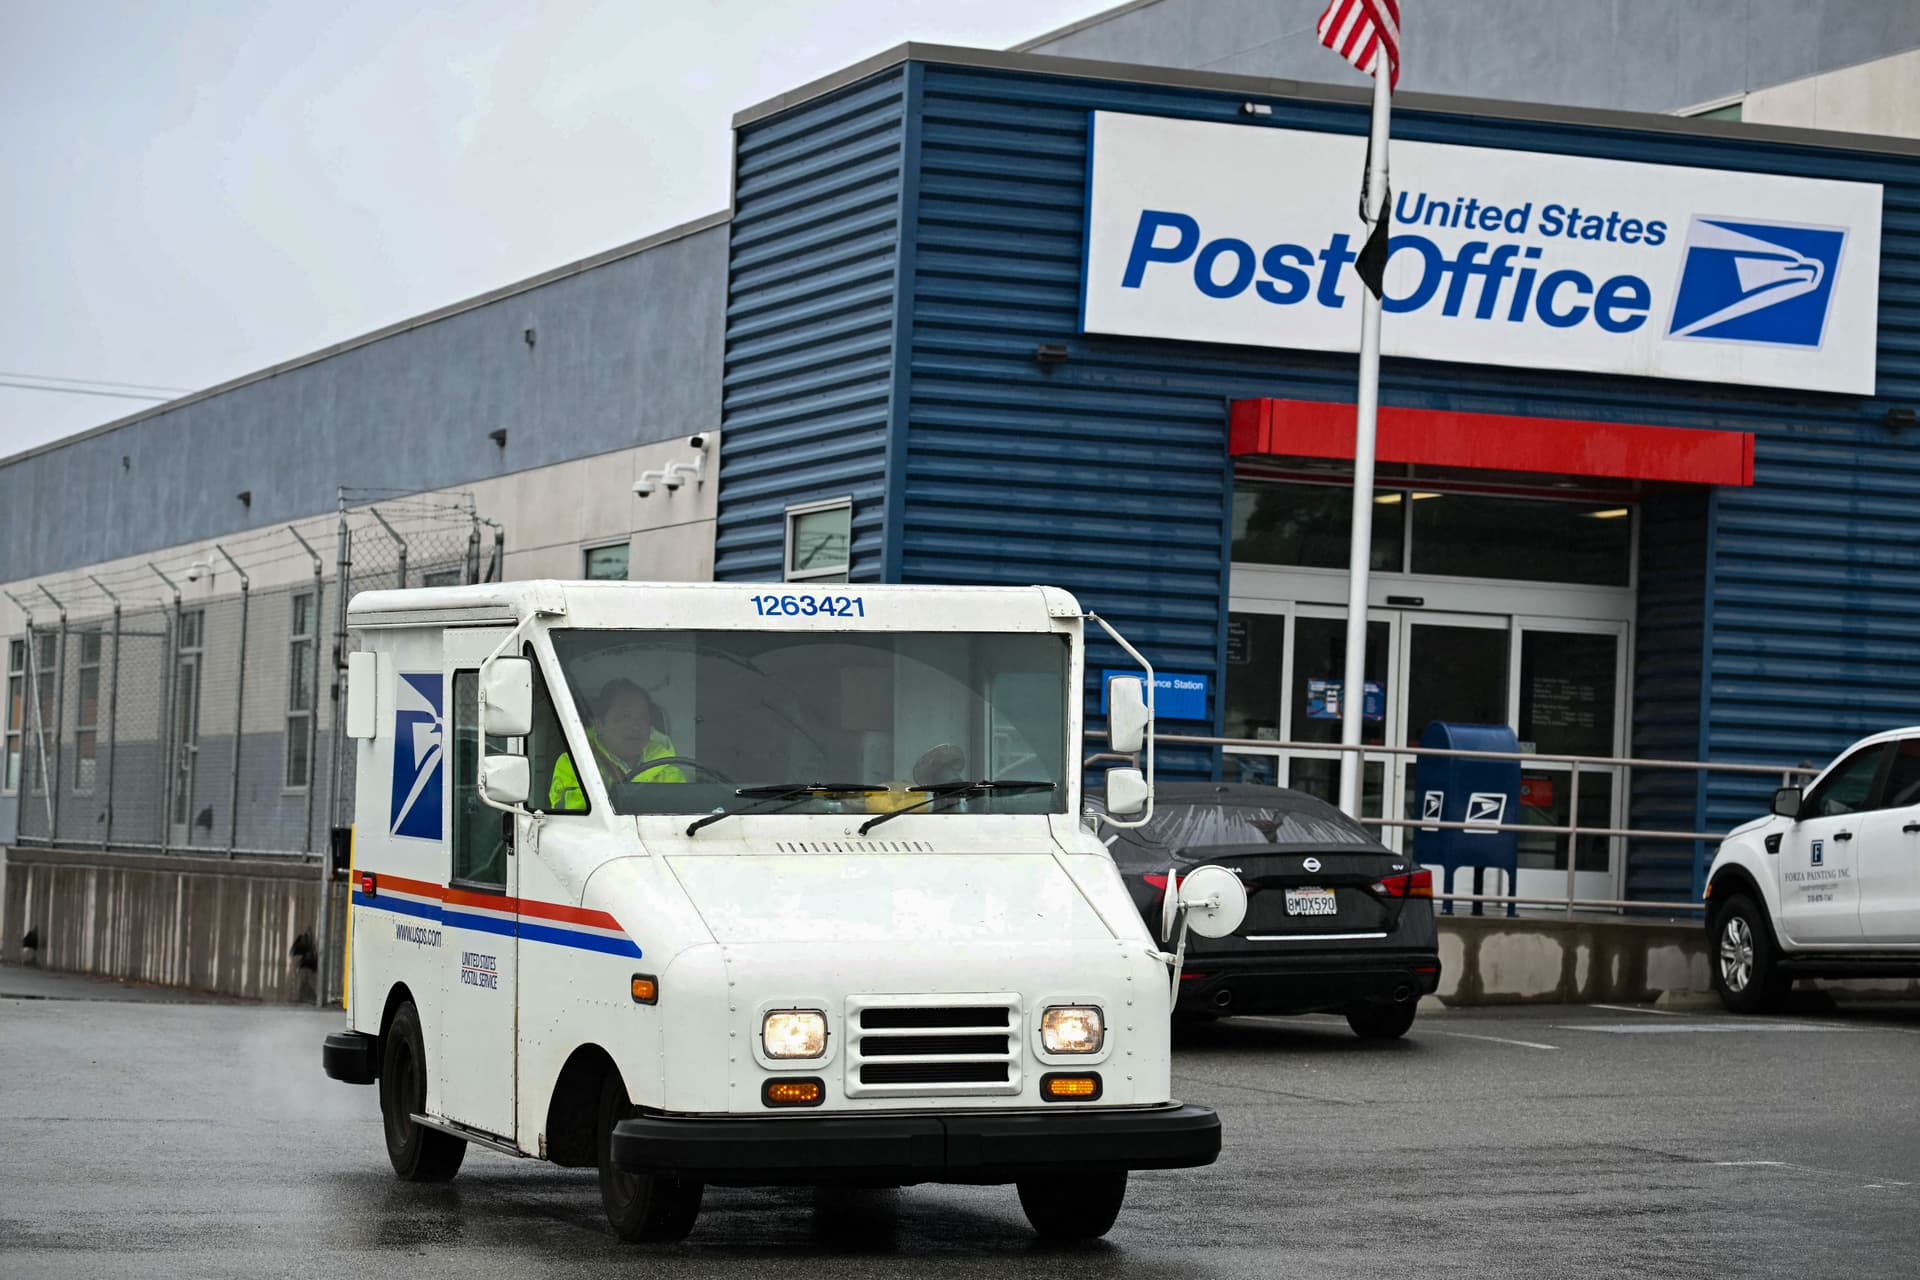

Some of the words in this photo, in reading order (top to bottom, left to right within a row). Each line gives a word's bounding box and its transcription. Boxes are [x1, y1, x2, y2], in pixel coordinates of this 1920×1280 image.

[1396, 191, 1532, 233] United
[1538, 204, 1667, 246] States
[1121, 209, 1356, 308] Post
[1382, 234, 1651, 333] Office
[750, 595, 865, 617] 1263421
[1174, 679, 1204, 690] Station
[1807, 870, 1837, 880] PAINTING
[1288, 897, 1335, 912] 8MDX590
[396, 924, 442, 950] www.usps.com
[462, 951, 480, 968] UNITED
[480, 955, 497, 971] STATES
[461, 969, 478, 986] POSTAL
[479, 973, 498, 990] SERVICE
